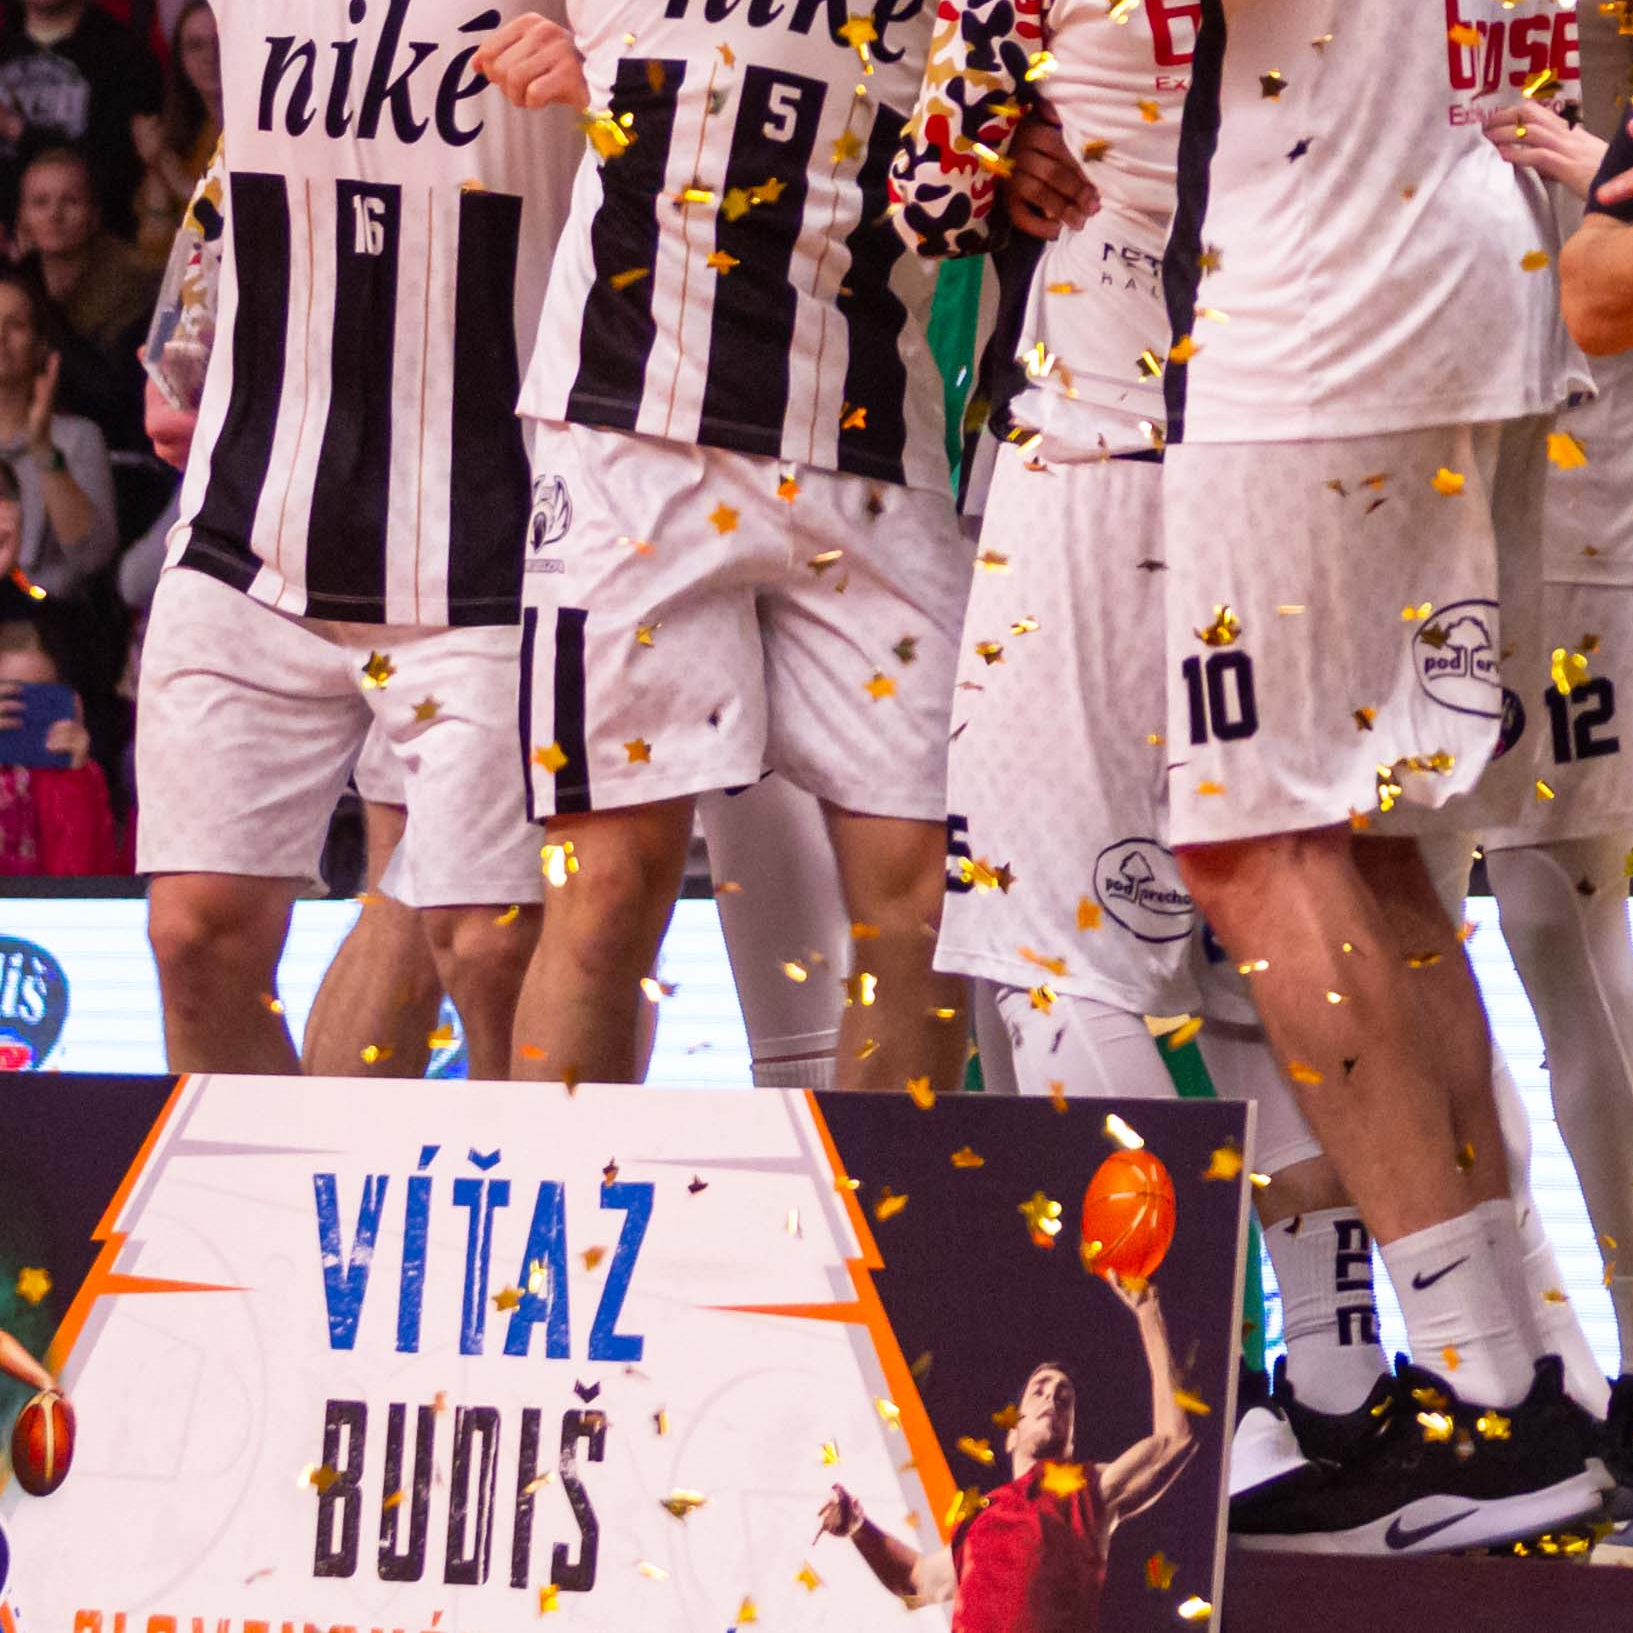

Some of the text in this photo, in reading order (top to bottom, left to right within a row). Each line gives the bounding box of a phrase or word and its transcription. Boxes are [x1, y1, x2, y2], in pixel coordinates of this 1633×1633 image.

[763, 82, 802, 143] 5
[352, 193, 386, 256] 16
[1181, 650, 1258, 746] 10
[1544, 676, 1620, 764] 12
[313, 1145, 656, 1363] VÍŤAZ
[313, 1380, 606, 1593] BUDIŠ
